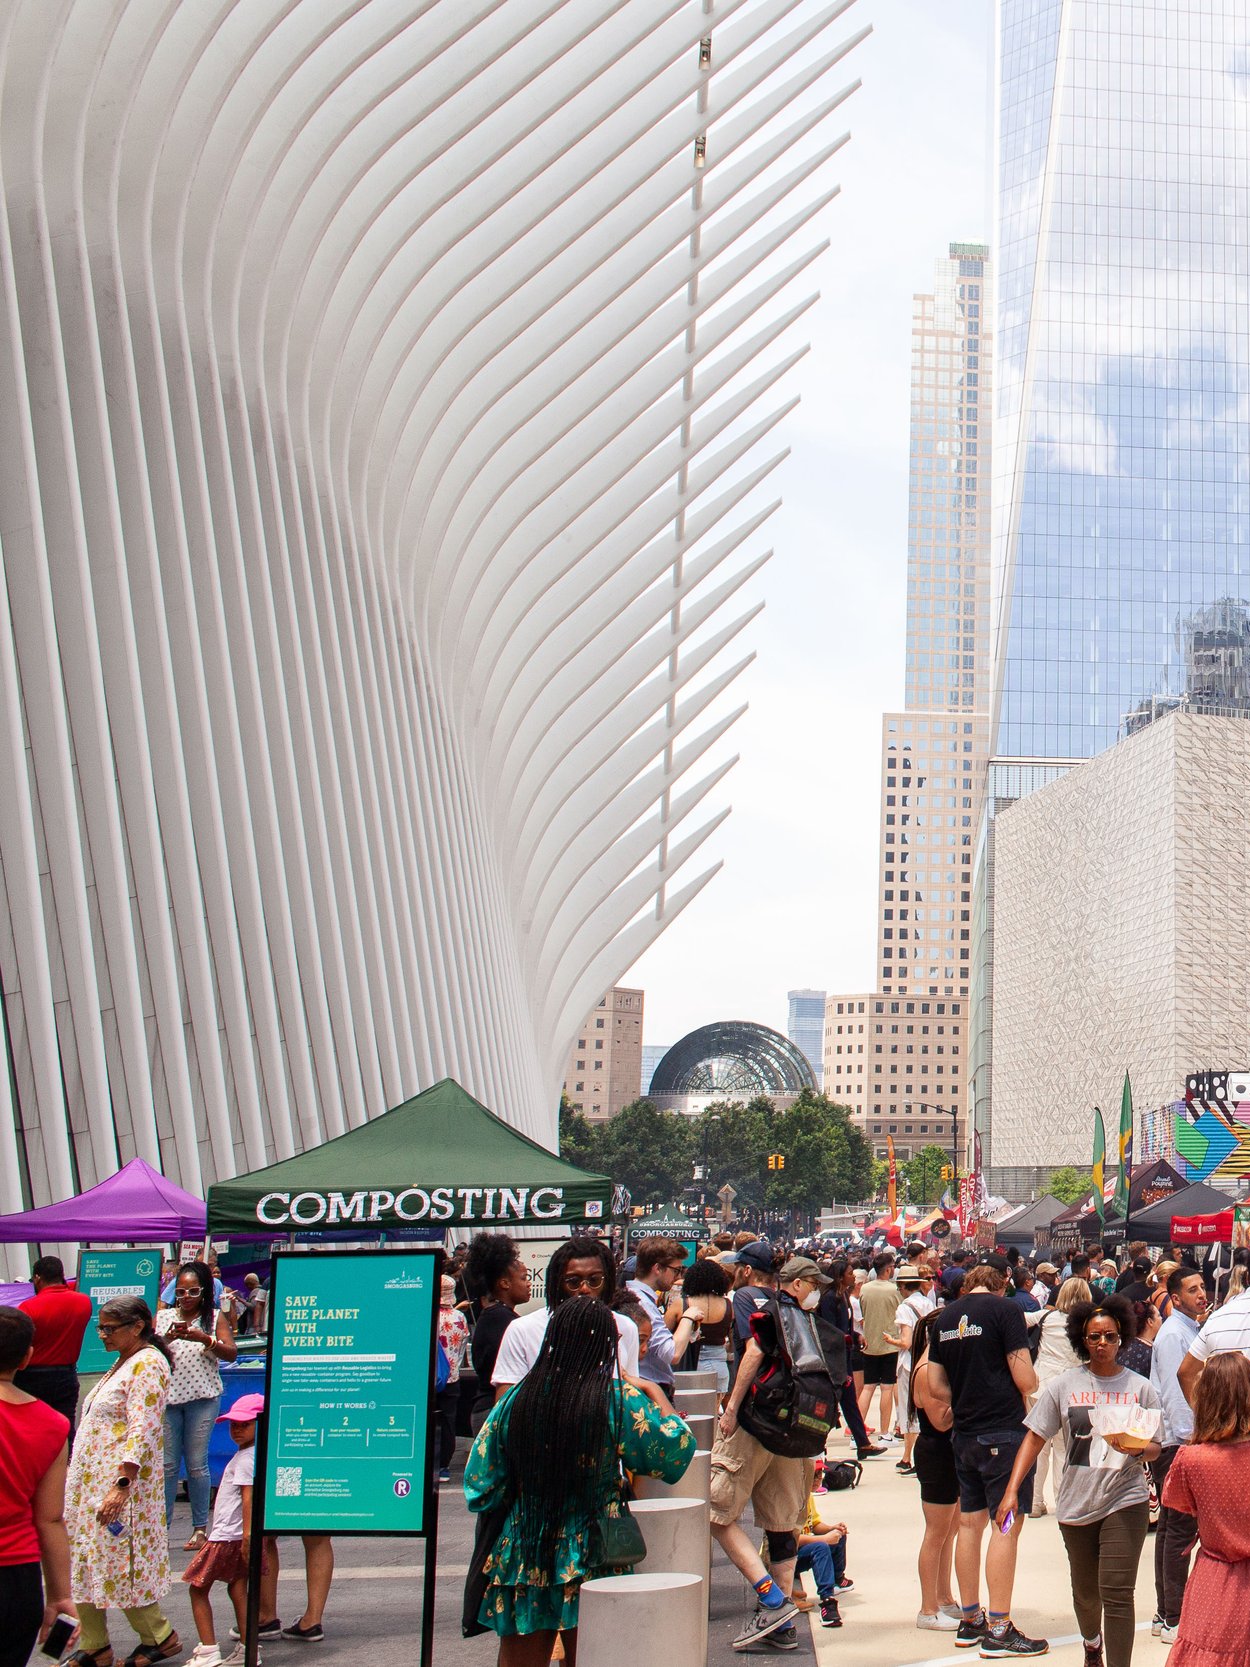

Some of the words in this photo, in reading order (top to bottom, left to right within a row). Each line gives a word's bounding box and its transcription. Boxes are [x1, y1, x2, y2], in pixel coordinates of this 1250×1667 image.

[256, 1188, 565, 1225] COMPOSTING
[631, 1230, 700, 1238] COMPOSTING
[92, 1287, 144, 1296] REUSABLES
[285, 1296, 317, 1307] SAVE
[285, 1310, 309, 1320] THE
[312, 1308, 360, 1319] PLANET
[284, 1323, 317, 1333] WITH
[283, 1336, 323, 1347] EVERY
[326, 1336, 354, 1346] BITE
[940, 1330, 960, 1343] home
[1068, 1391, 1140, 1405] ARETHA
[299, 1416, 304, 1425] 1
[343, 1416, 349, 1426] 2
[389, 1416, 395, 1425] 3
[398, 1481, 407, 1495] R
